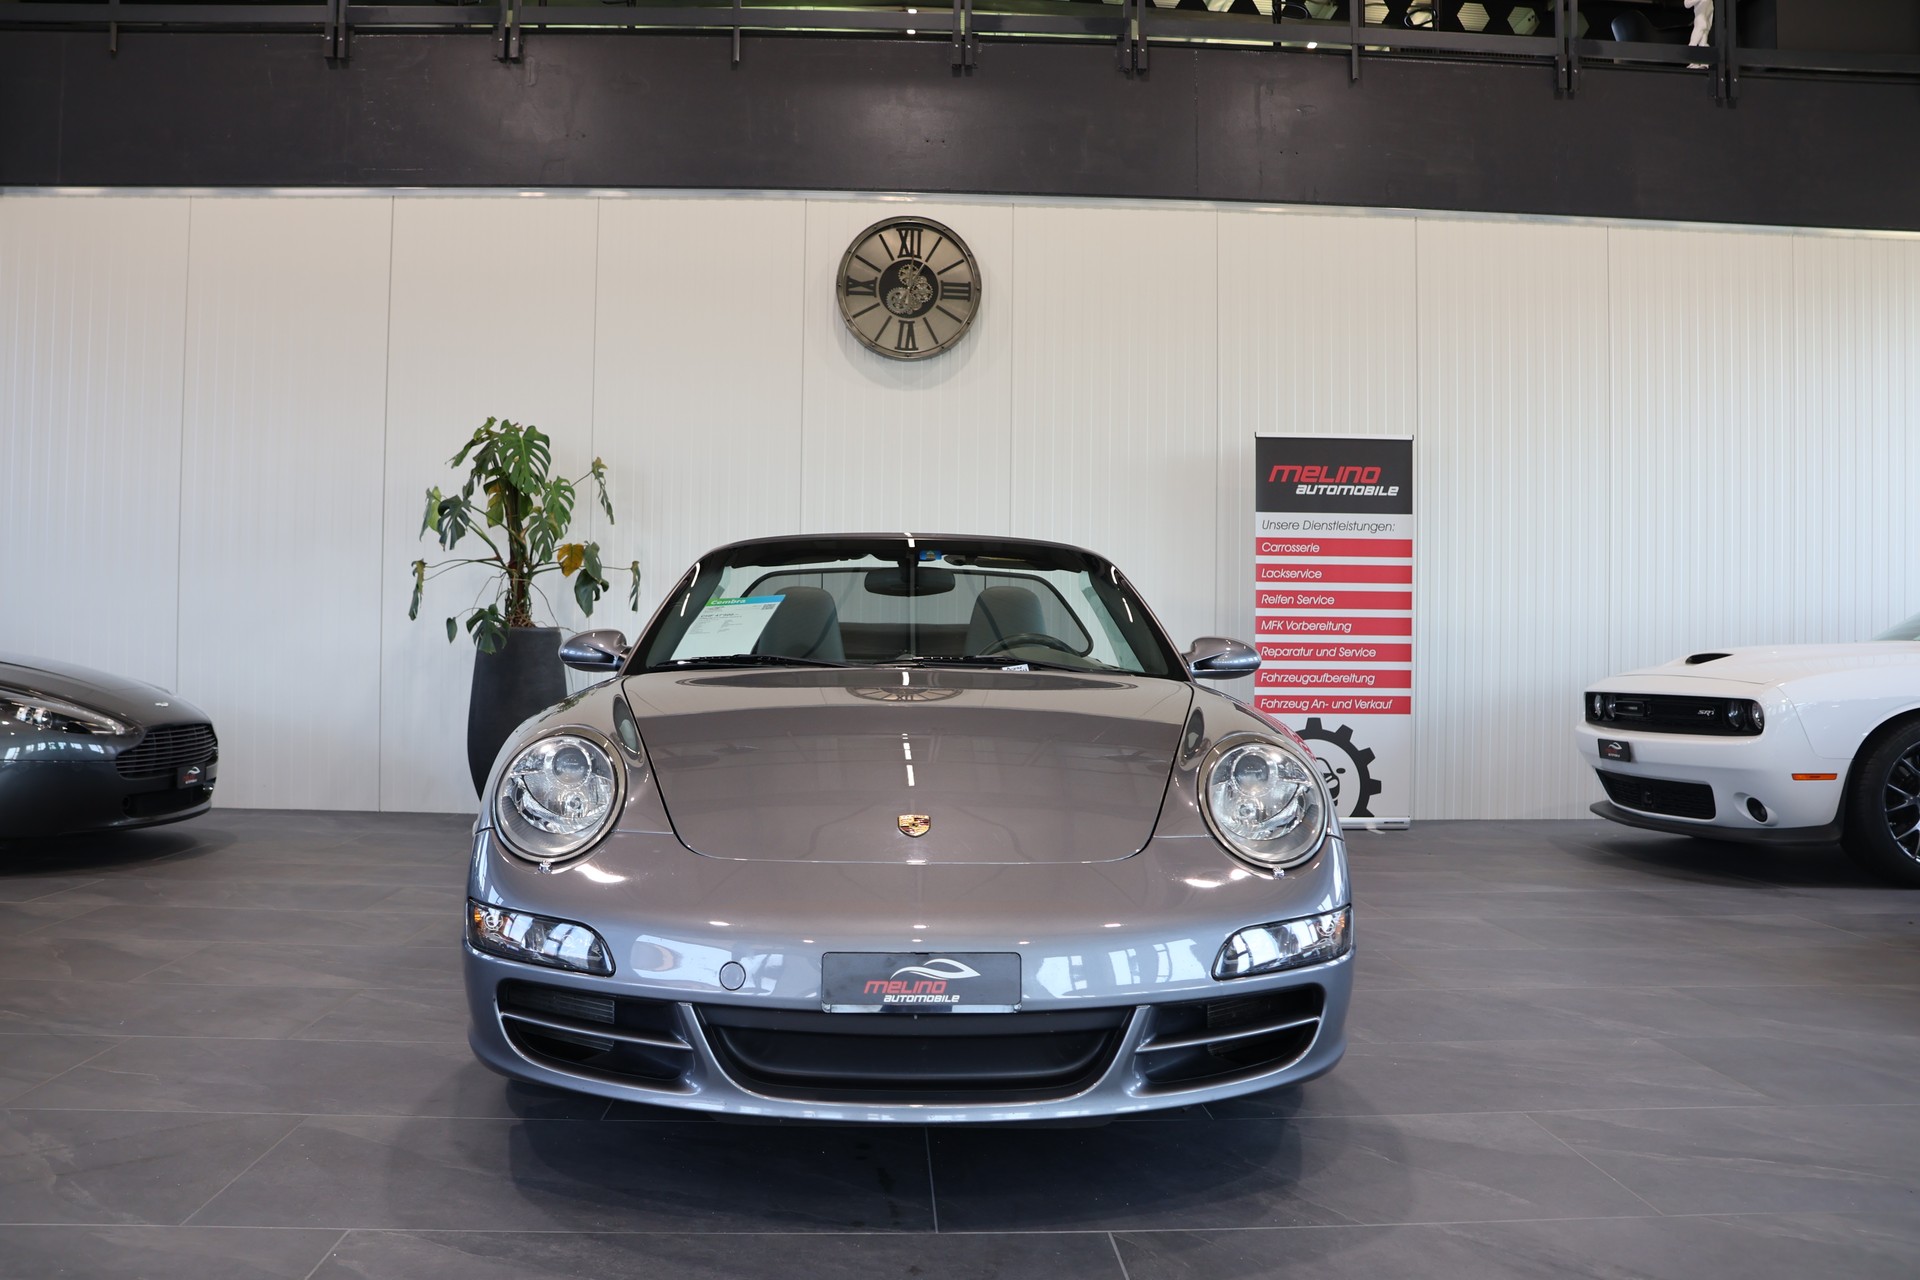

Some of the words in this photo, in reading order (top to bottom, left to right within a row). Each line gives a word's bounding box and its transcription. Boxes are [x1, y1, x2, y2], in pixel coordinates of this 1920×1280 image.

[896, 228, 923, 259] XII
[1262, 520, 1300, 530] Unsere
[1303, 520, 1395, 534] Dienstleistungen:
[1262, 542, 1320, 553] Carrosserie
[1261, 568, 1322, 579] Lackservice
[1261, 594, 1295, 604] Reifen
[1296, 594, 1335, 605] Service
[1261, 620, 1285, 630] MFK
[1285, 621, 1352, 633] Vorbereitung
[1261, 646, 1313, 658] Reparatur
[1316, 647, 1337, 657] und
[1338, 647, 1377, 657] Service
[1260, 673, 1375, 685] Fahrzeugaufbereitung
[1260, 698, 1310, 711] Fahrzeug
[1311, 699, 1329, 709] An-
[1331, 699, 1353, 709] und
[1354, 699, 1393, 709] Verkauf
